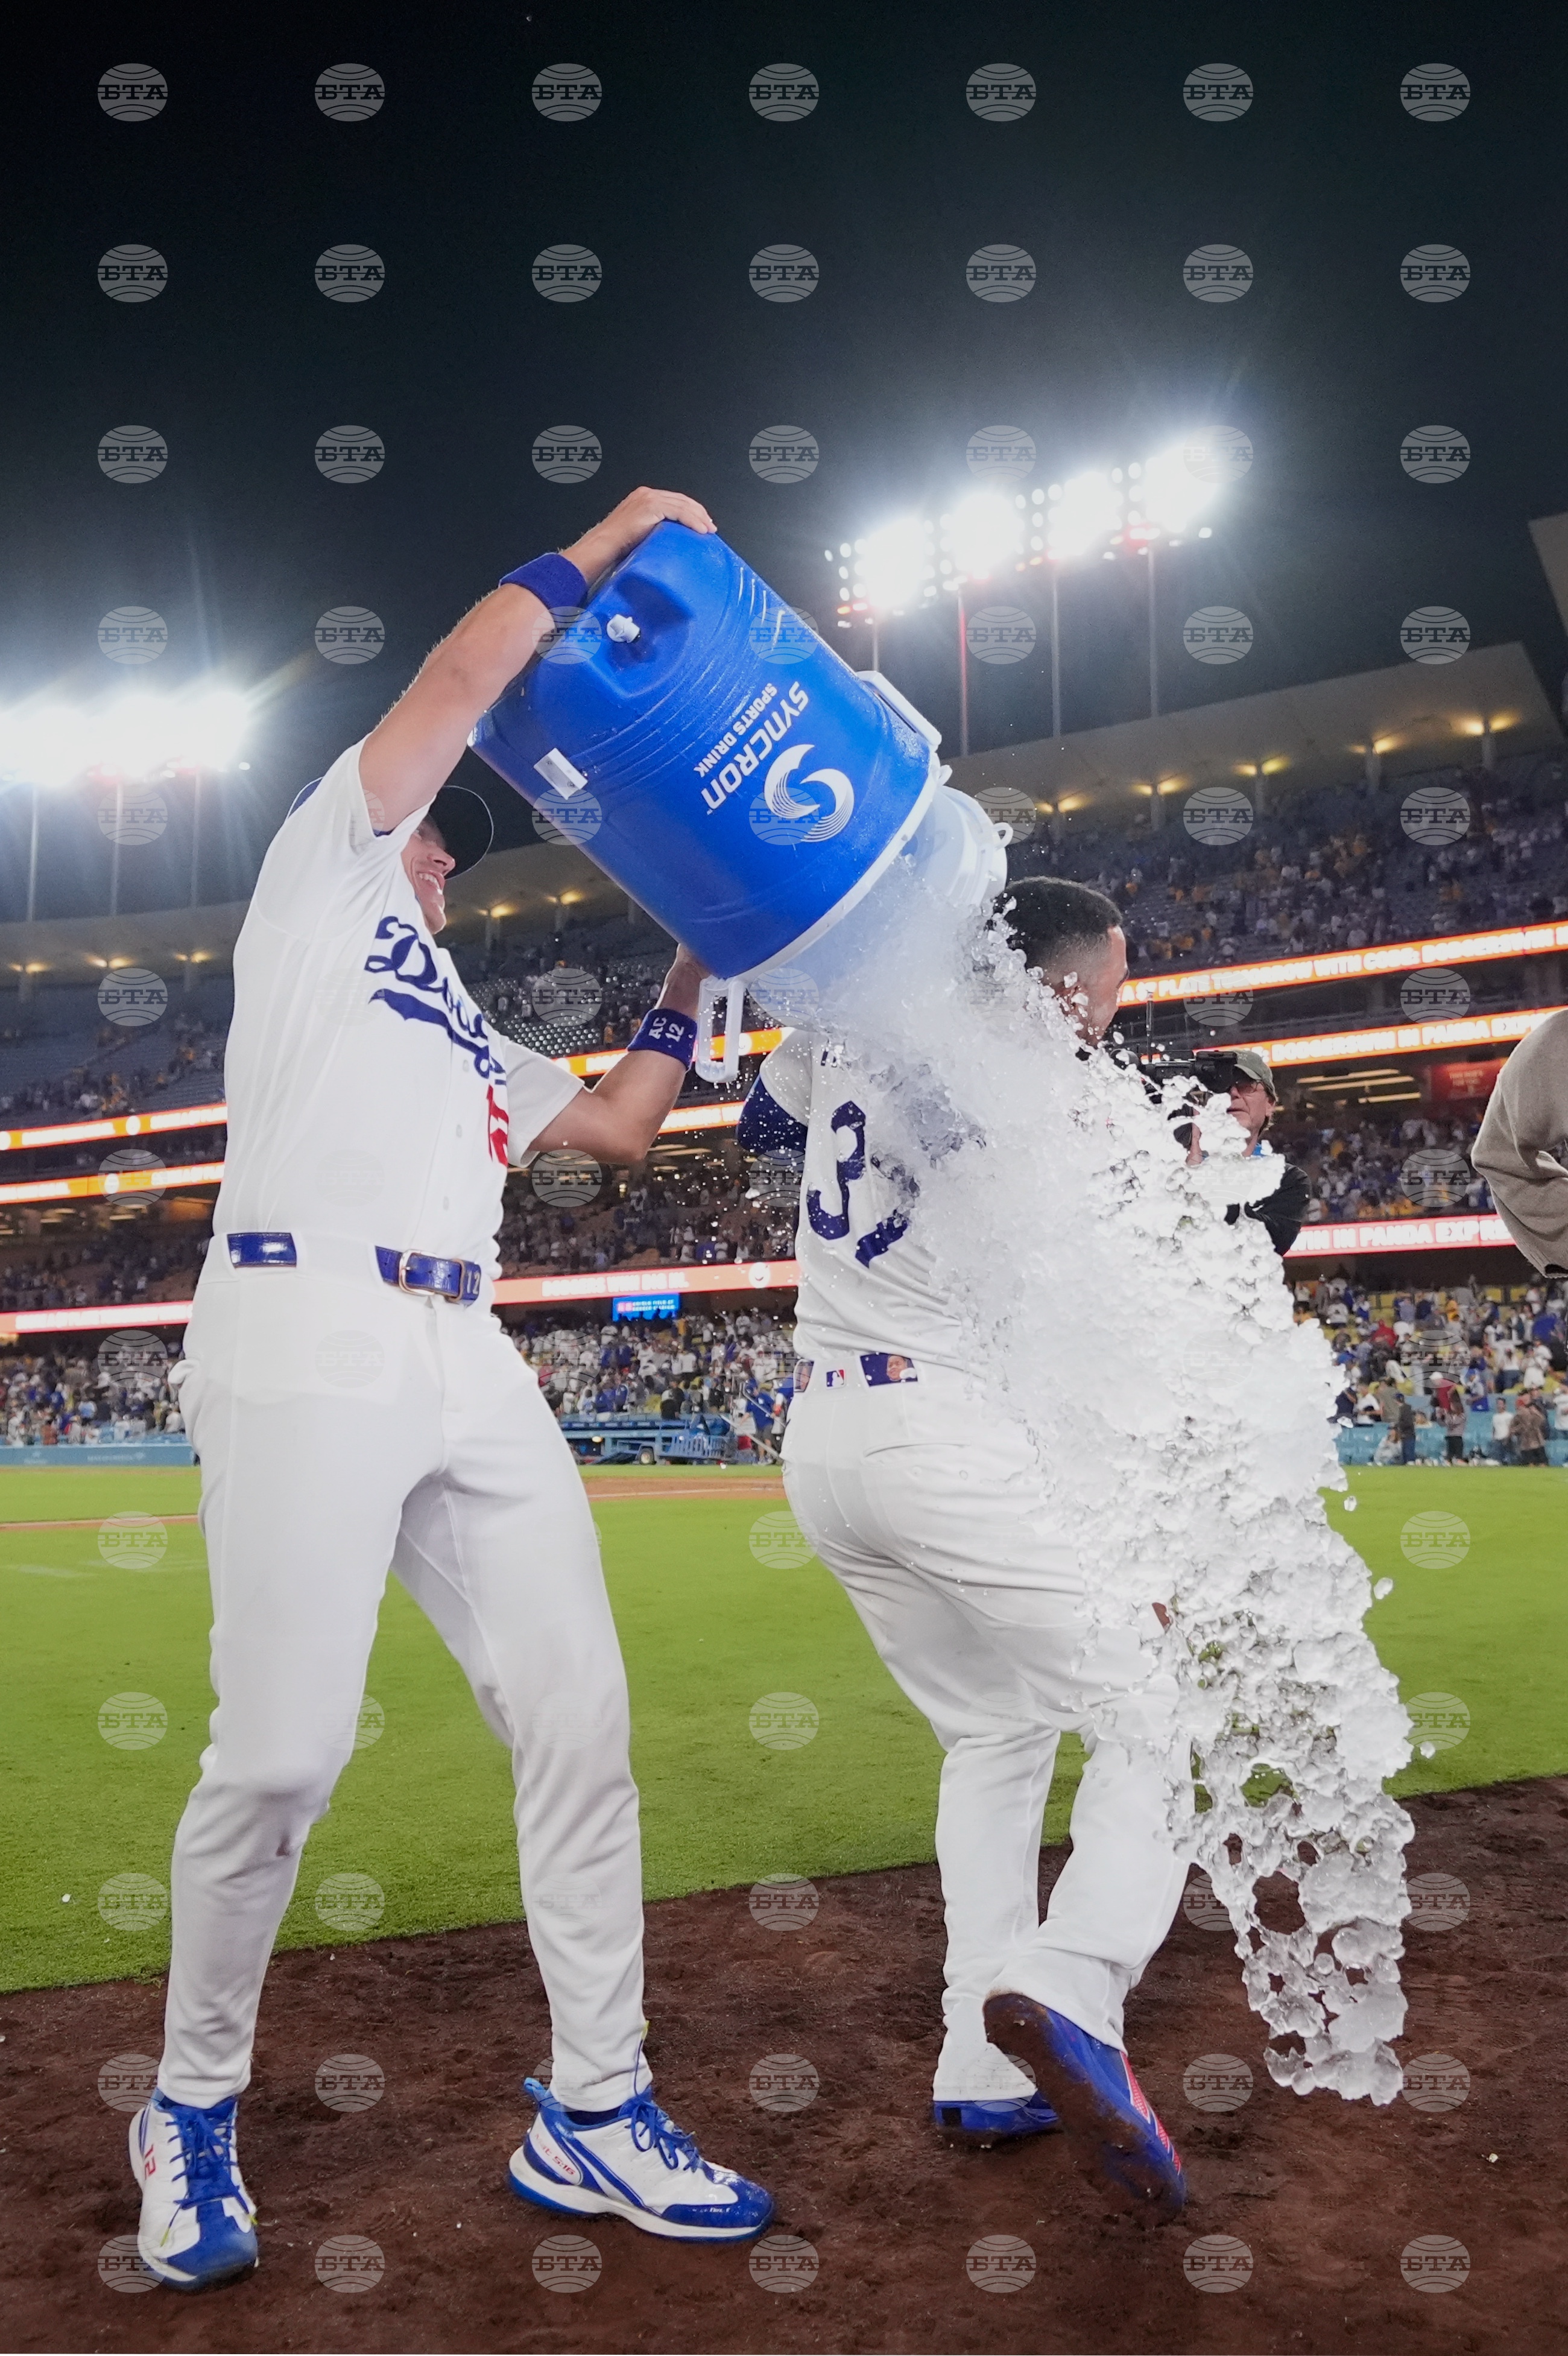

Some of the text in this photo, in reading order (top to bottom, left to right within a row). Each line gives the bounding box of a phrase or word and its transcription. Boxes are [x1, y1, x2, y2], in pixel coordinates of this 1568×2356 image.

[693, 682, 778, 777] SPORTS DRINK
[1313, 954, 1362, 977] WITH
[648, 1017, 666, 1039] AC
[665, 1022, 684, 1042] 12
[1421, 1020, 1491, 1045] PANDA
[1333, 1228, 1356, 1249] IN
[1359, 1223, 1434, 1247] PANDA
[467, 1270, 480, 1295] 12
